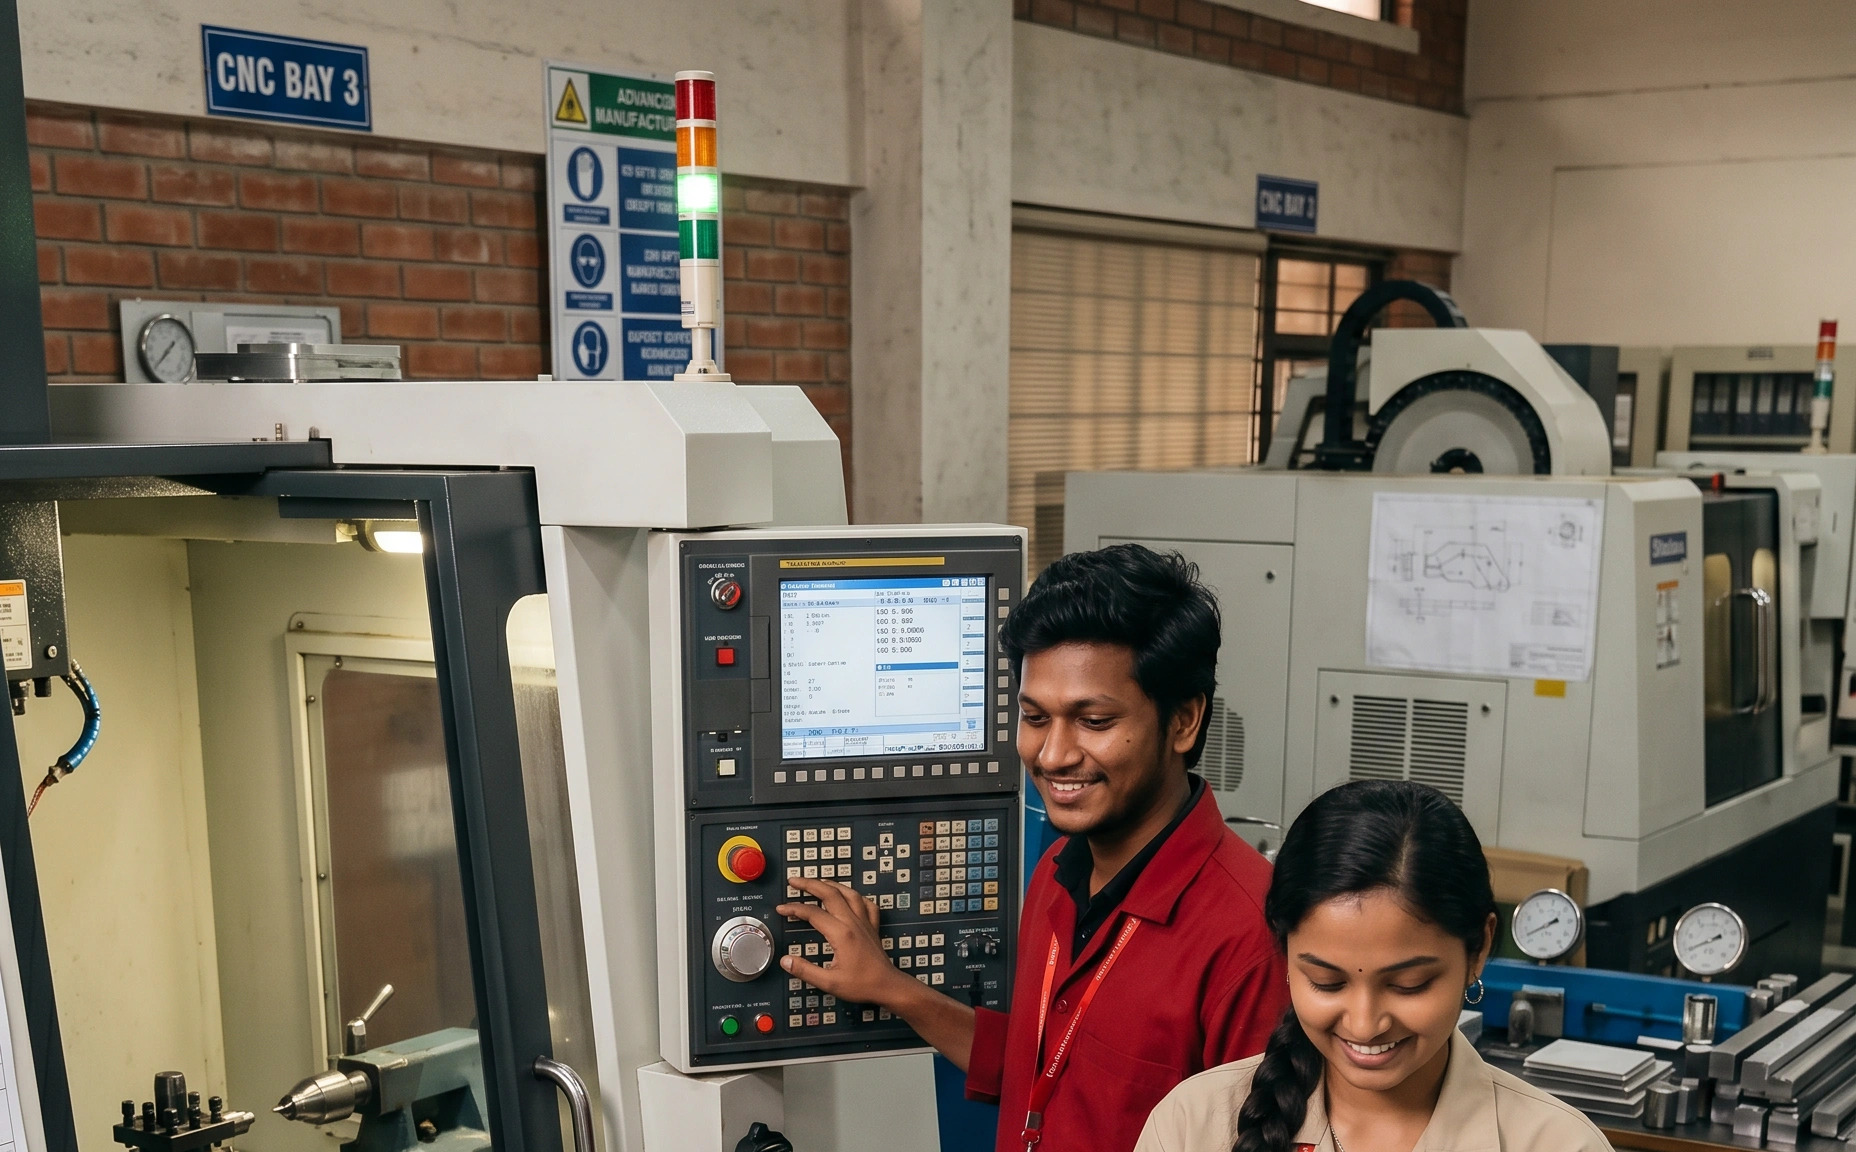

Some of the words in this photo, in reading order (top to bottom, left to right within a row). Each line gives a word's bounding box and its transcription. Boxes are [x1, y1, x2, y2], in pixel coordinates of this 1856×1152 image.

[217, 52, 276, 96] CNC
[284, 60, 335, 103] BAY
[343, 68, 360, 106] 3
